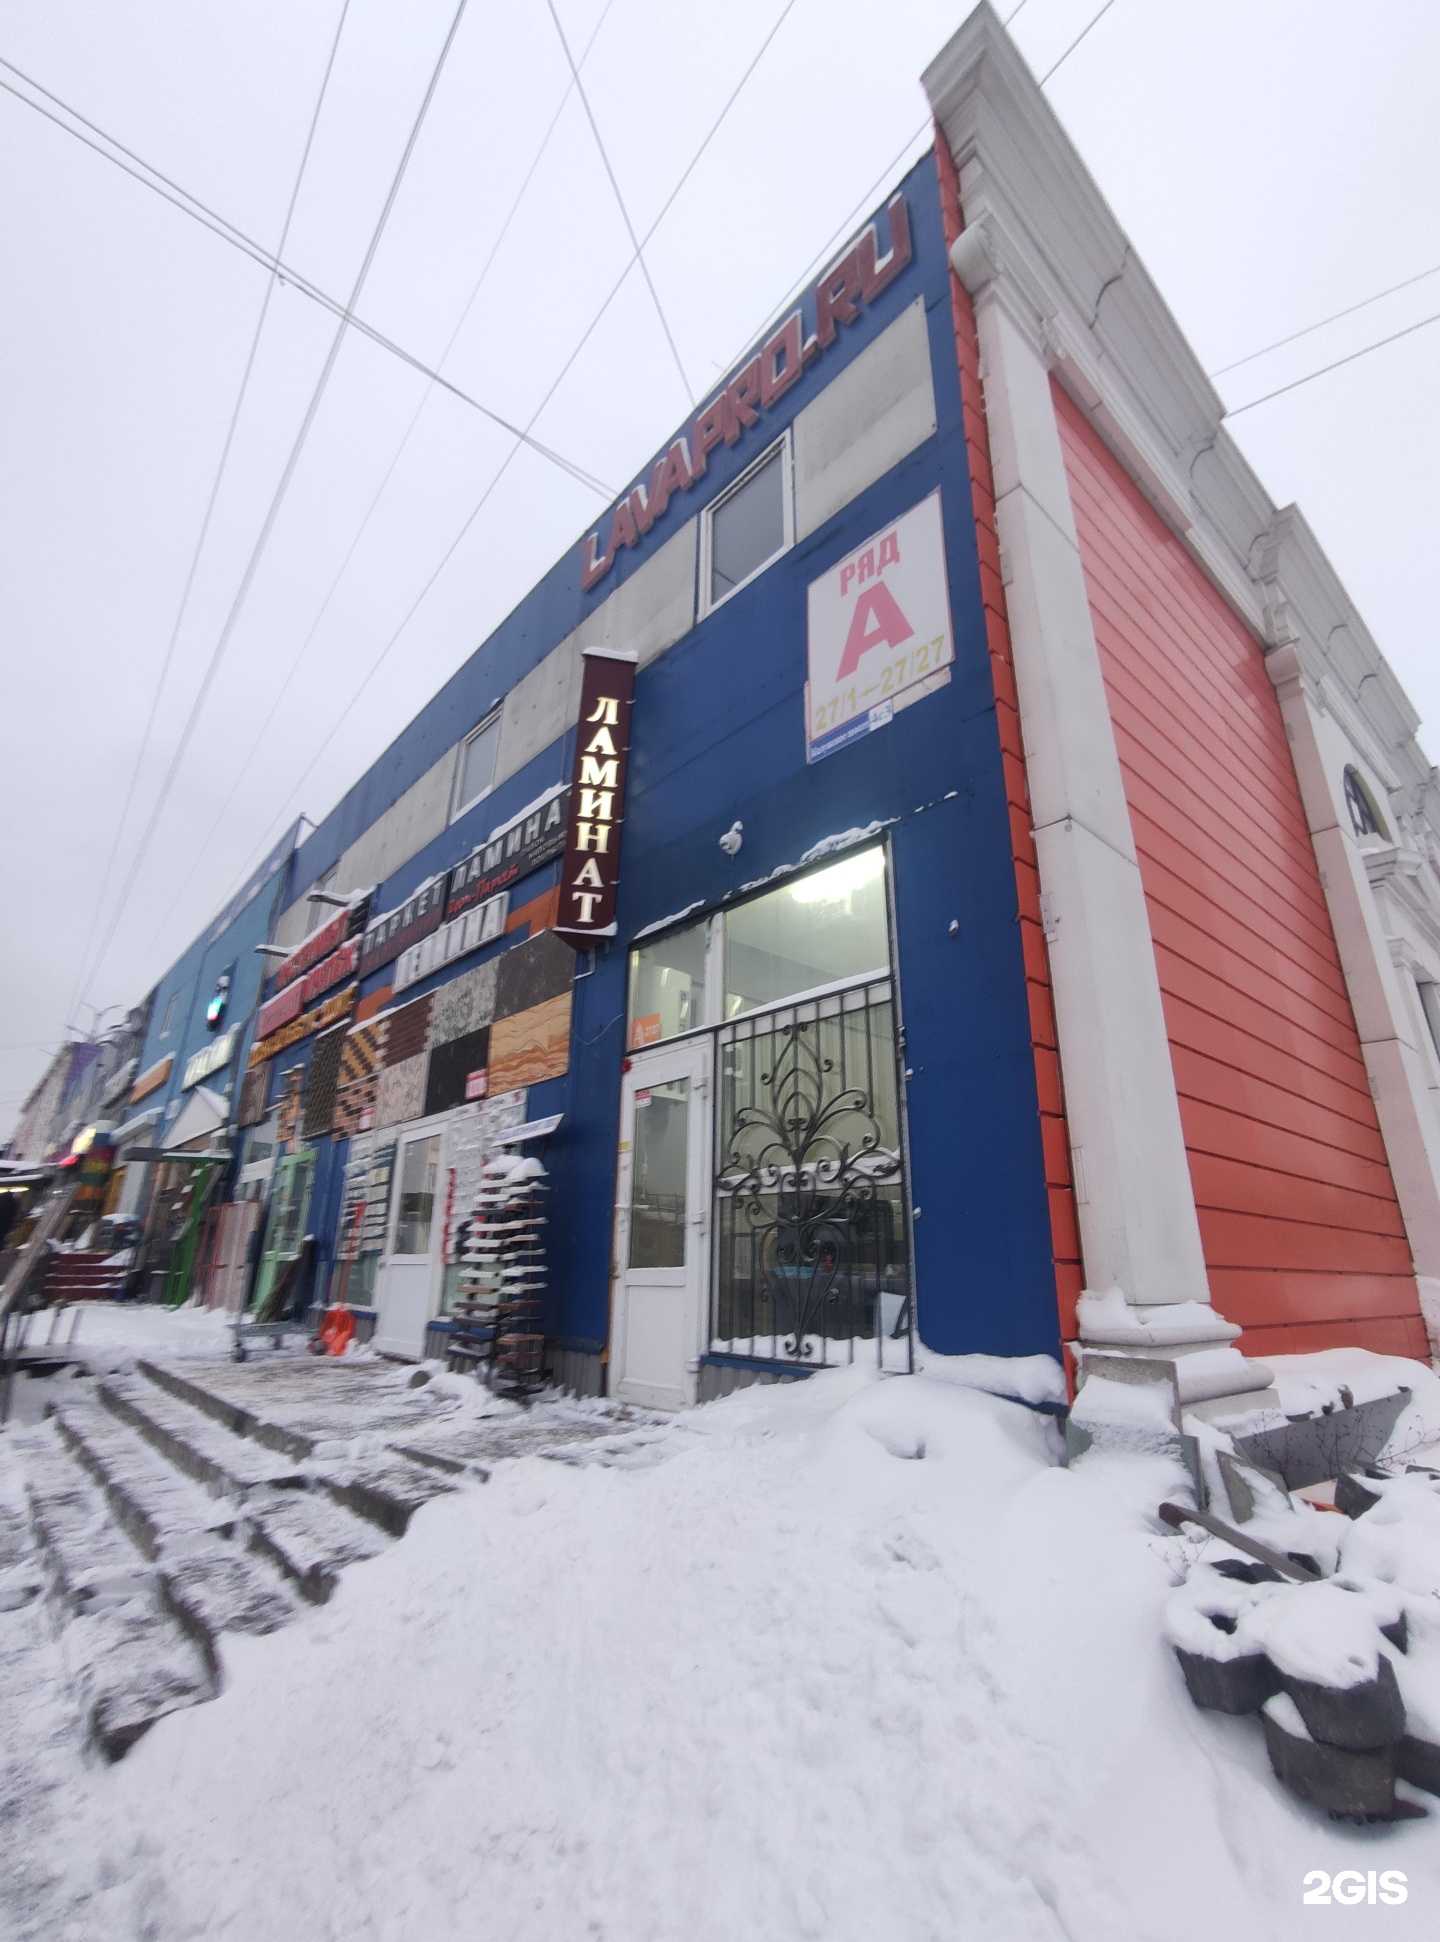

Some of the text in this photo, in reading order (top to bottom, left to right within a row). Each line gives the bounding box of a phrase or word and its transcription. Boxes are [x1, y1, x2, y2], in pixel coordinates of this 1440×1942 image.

[839, 531, 900, 597] РЯД
[836, 580, 915, 682] А
[451, 789, 572, 894] ЛАМИНА
[571, 697, 620, 923] ЛАМИНАТ
[362, 880, 443, 955] ПАРКЕТ
